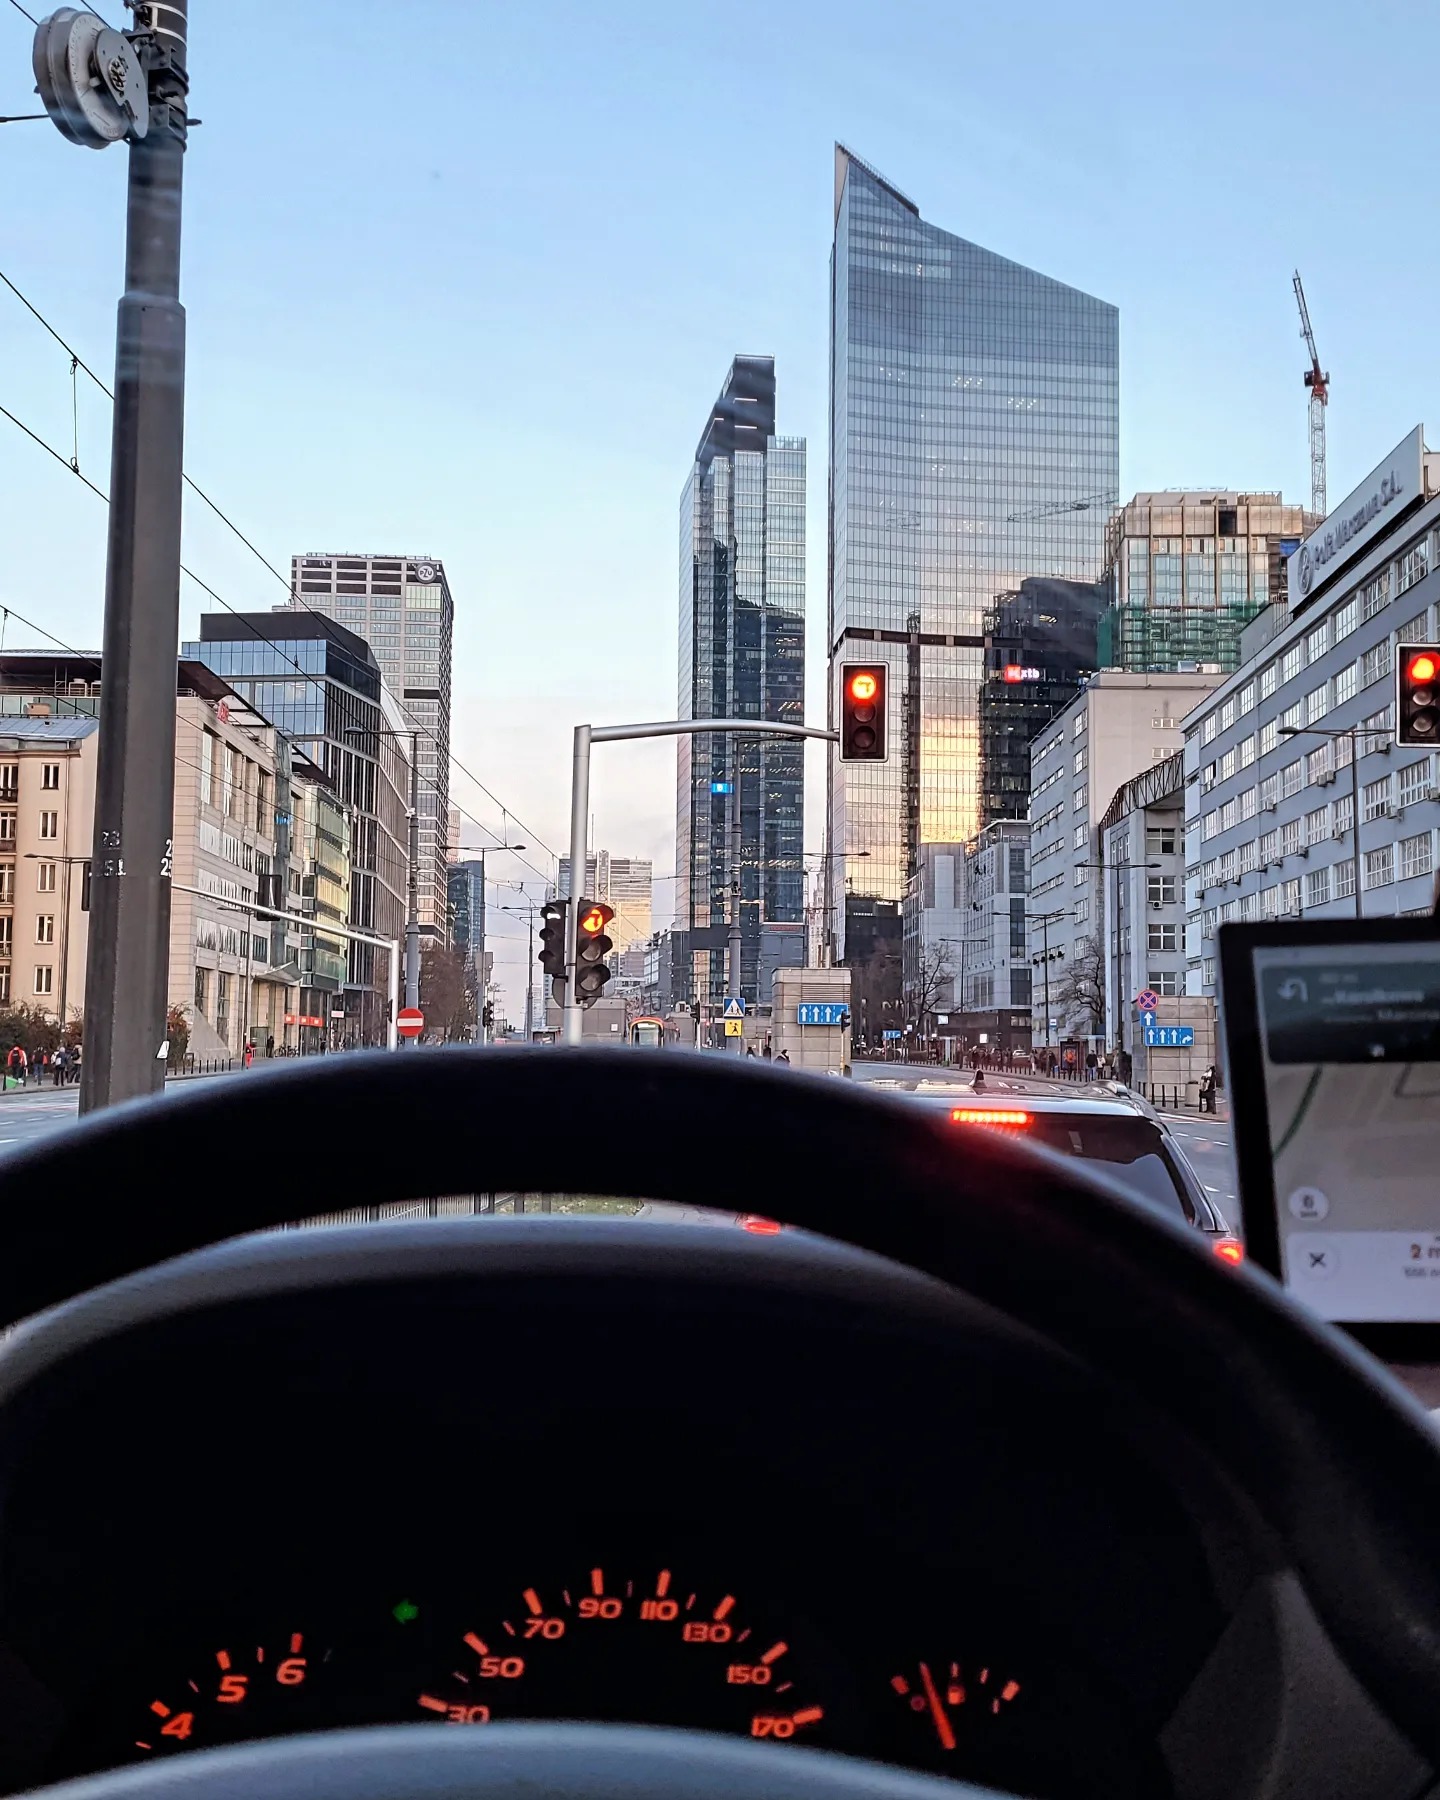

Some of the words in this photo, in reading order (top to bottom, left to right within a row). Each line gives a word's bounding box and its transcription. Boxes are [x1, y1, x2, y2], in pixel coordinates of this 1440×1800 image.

[578, 1598, 622, 1619] 90
[640, 1600, 679, 1621] 110
[524, 1618, 565, 1639] 70
[683, 1622, 732, 1643] 130
[276, 1658, 307, 1685] 6
[479, 1657, 525, 1678] 50
[727, 1665, 772, 1685] 150
[216, 1675, 248, 1702] 5
[447, 1705, 490, 1725] 30
[161, 1712, 193, 1740] 4
[751, 1716, 795, 1738] 170
